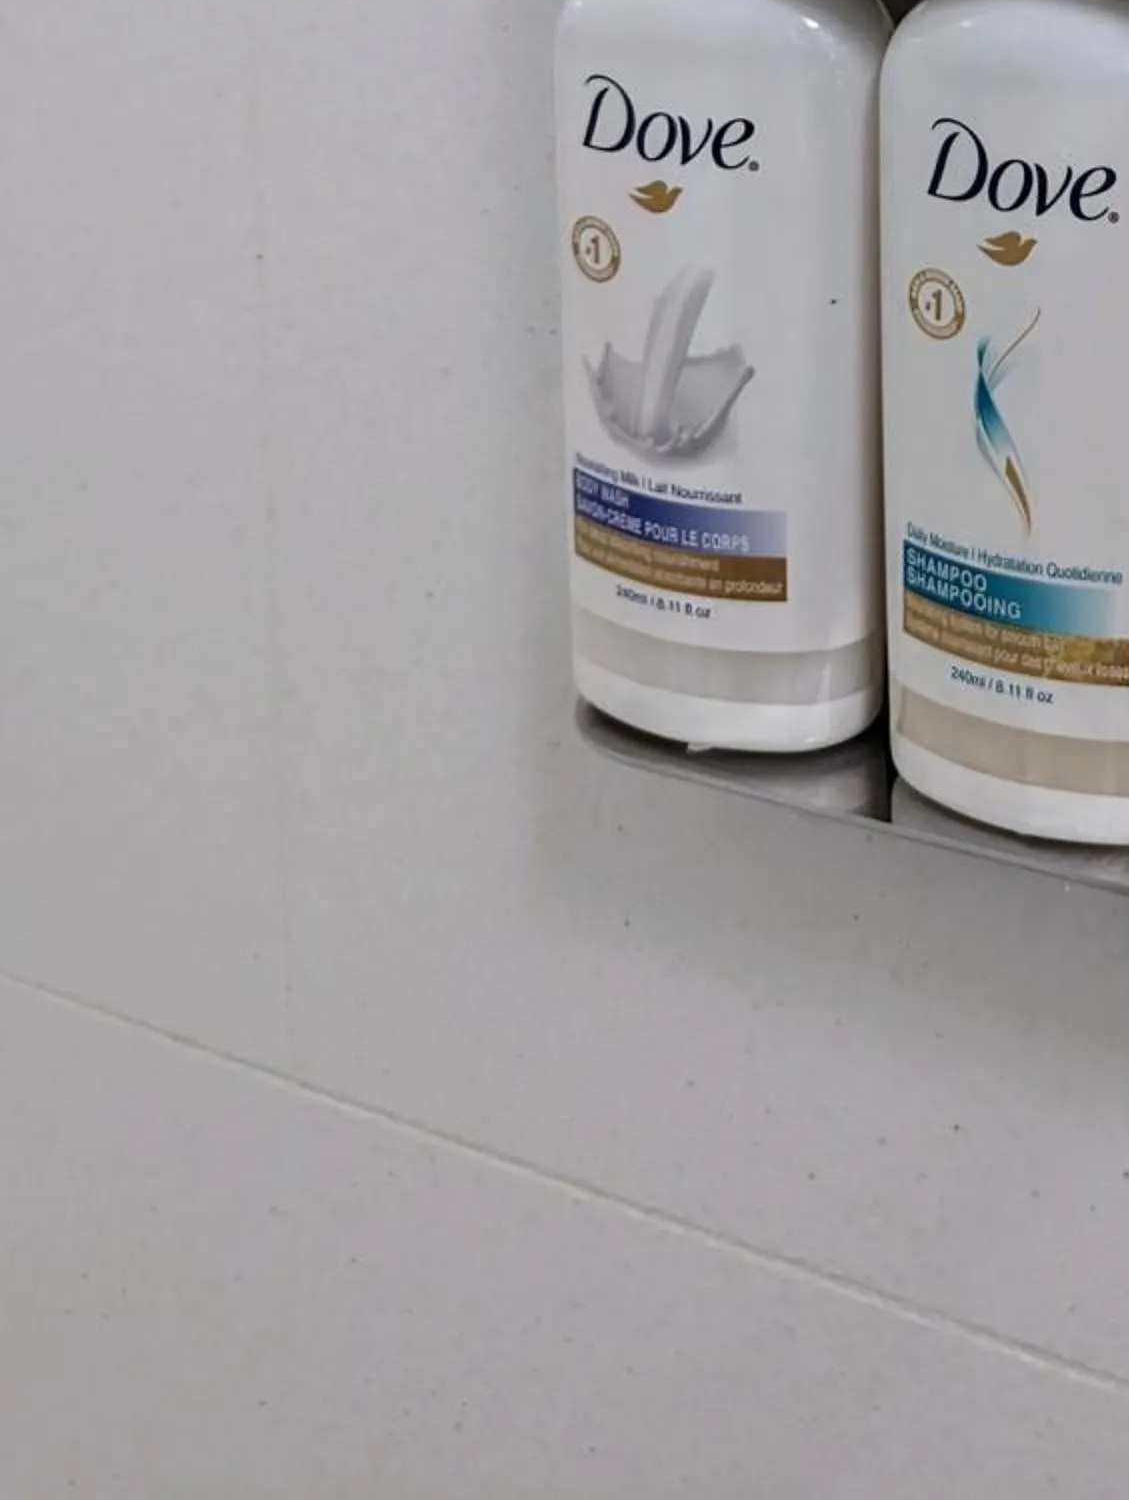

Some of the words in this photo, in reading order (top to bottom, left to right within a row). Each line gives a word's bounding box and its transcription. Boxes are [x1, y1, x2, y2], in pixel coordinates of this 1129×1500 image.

[582, 74, 755, 170] Dove
[927, 117, 1117, 221] Dove
[643, 520, 679, 543] POUR
[681, 529, 699, 548] LE
[702, 531, 749, 552] CORPS
[906, 547, 987, 593] SHAMPOO
[906, 565, 1021, 619] SHAMPOOING
[951, 665, 986, 687] 240ml
[1037, 691, 1053, 704] oz
